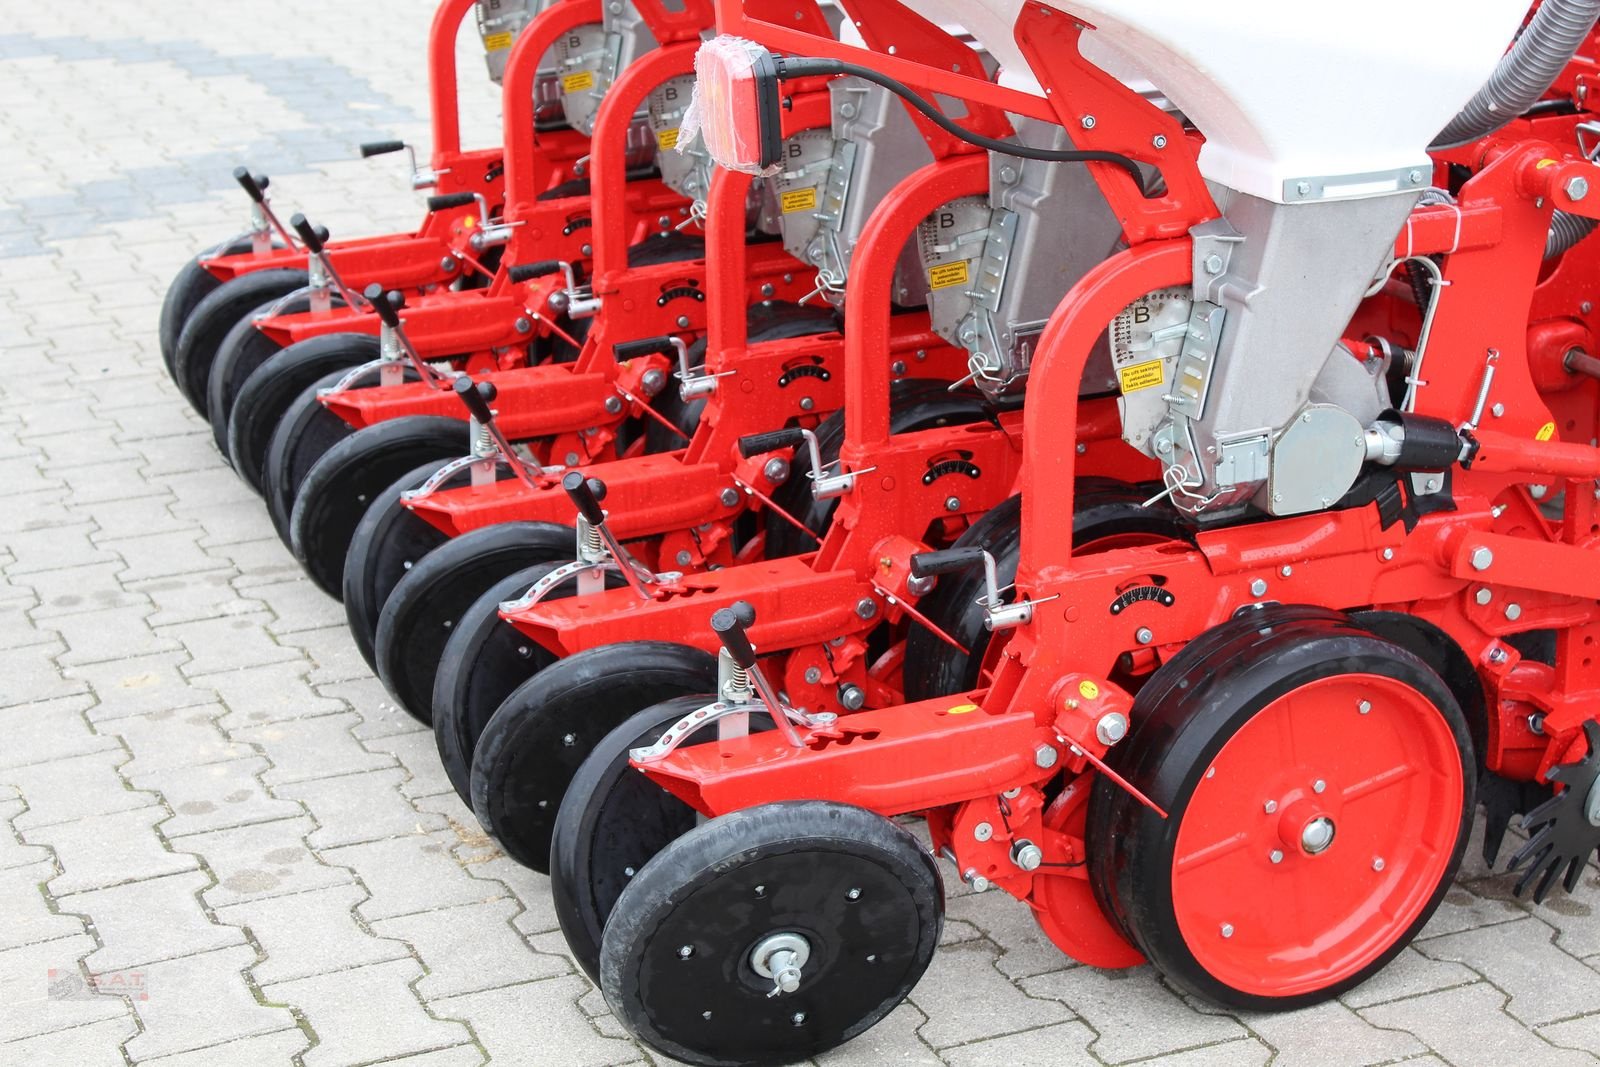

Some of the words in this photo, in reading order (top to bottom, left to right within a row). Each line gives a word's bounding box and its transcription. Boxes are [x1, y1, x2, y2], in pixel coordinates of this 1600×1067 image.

[569, 36, 581, 48] B
[665, 87, 678, 101] B
[789, 144, 802, 158] B
[940, 213, 955, 228] B
[1134, 306, 1150, 324] B
